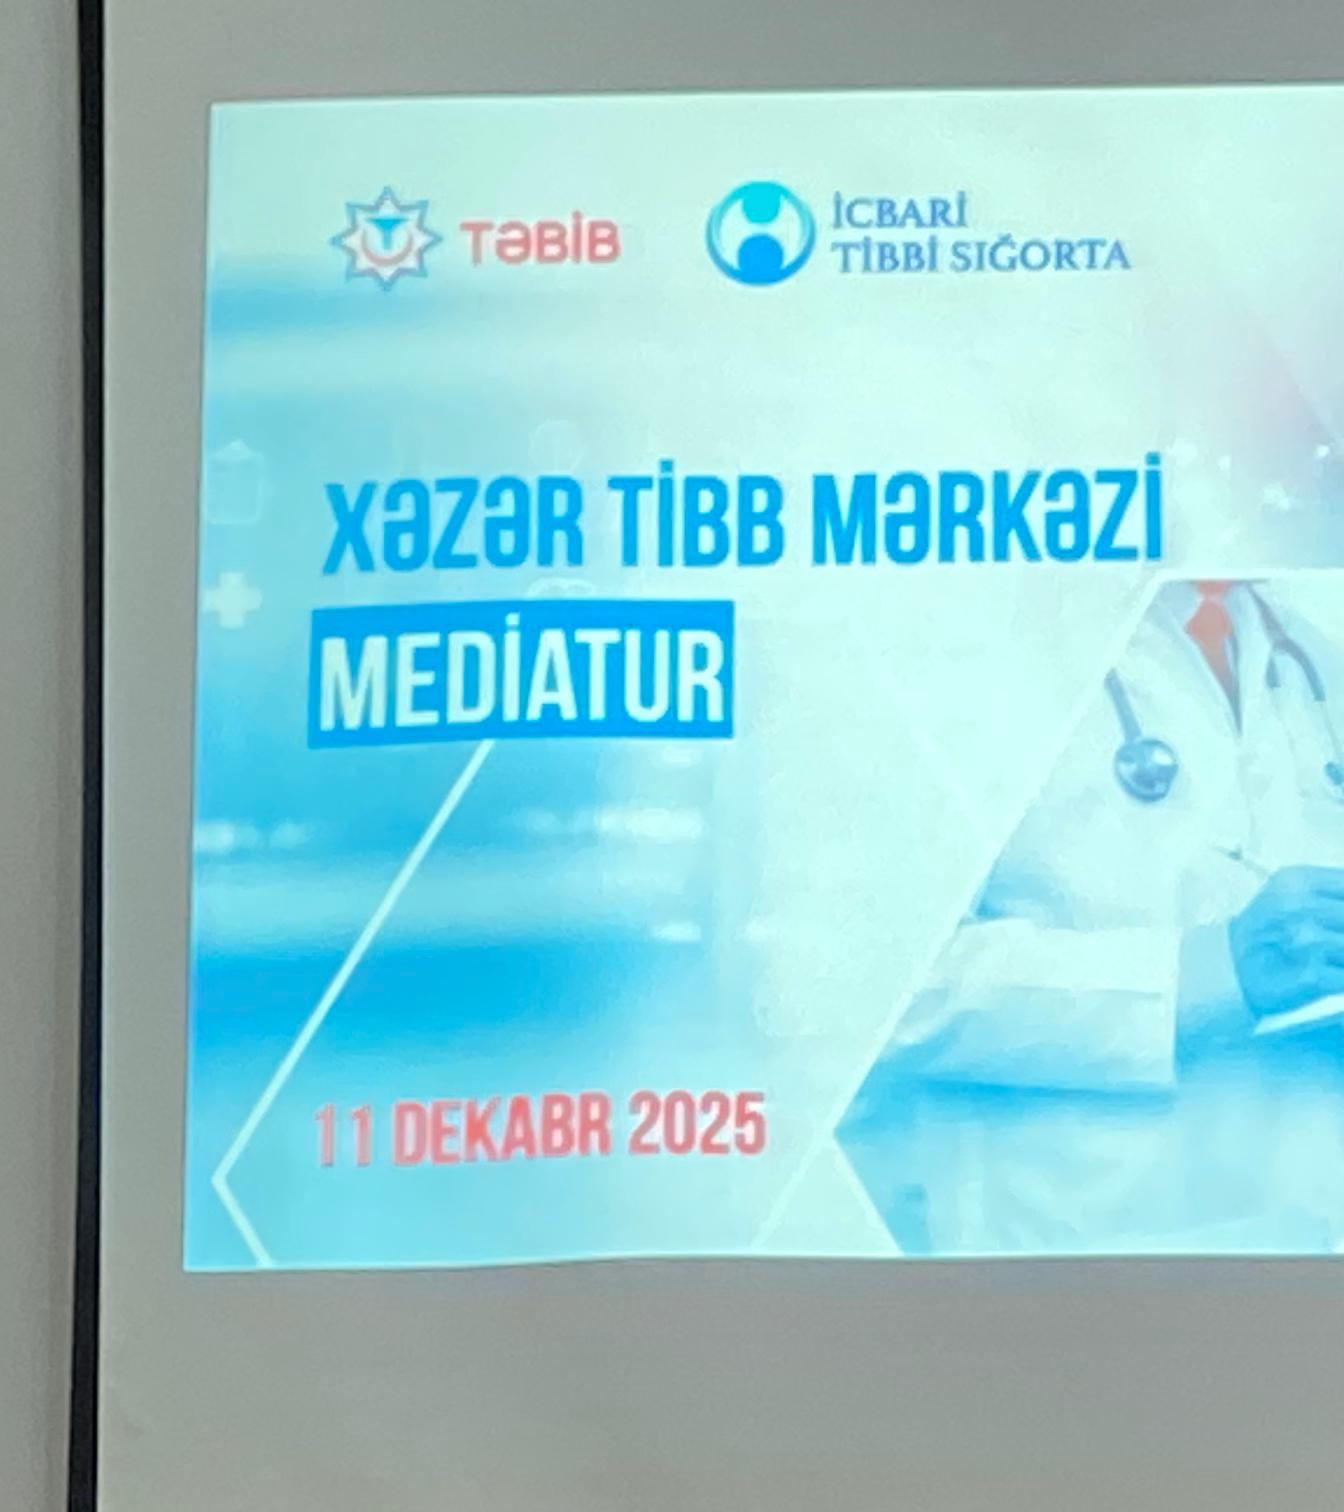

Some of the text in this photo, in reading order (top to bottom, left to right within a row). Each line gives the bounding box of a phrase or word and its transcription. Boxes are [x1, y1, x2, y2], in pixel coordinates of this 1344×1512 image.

[460, 211, 621, 266] TƏBİB
[833, 190, 968, 230] İCBARİ
[831, 234, 1132, 274] TİBBİ SIĞORTA
[323, 452, 1164, 575] XƏZƏR TİBB MƏRKƏZİ
[319, 612, 726, 732] MEDİATUR
[392, 1093, 612, 1166] DEKABR
[628, 1090, 767, 1155] 2025
